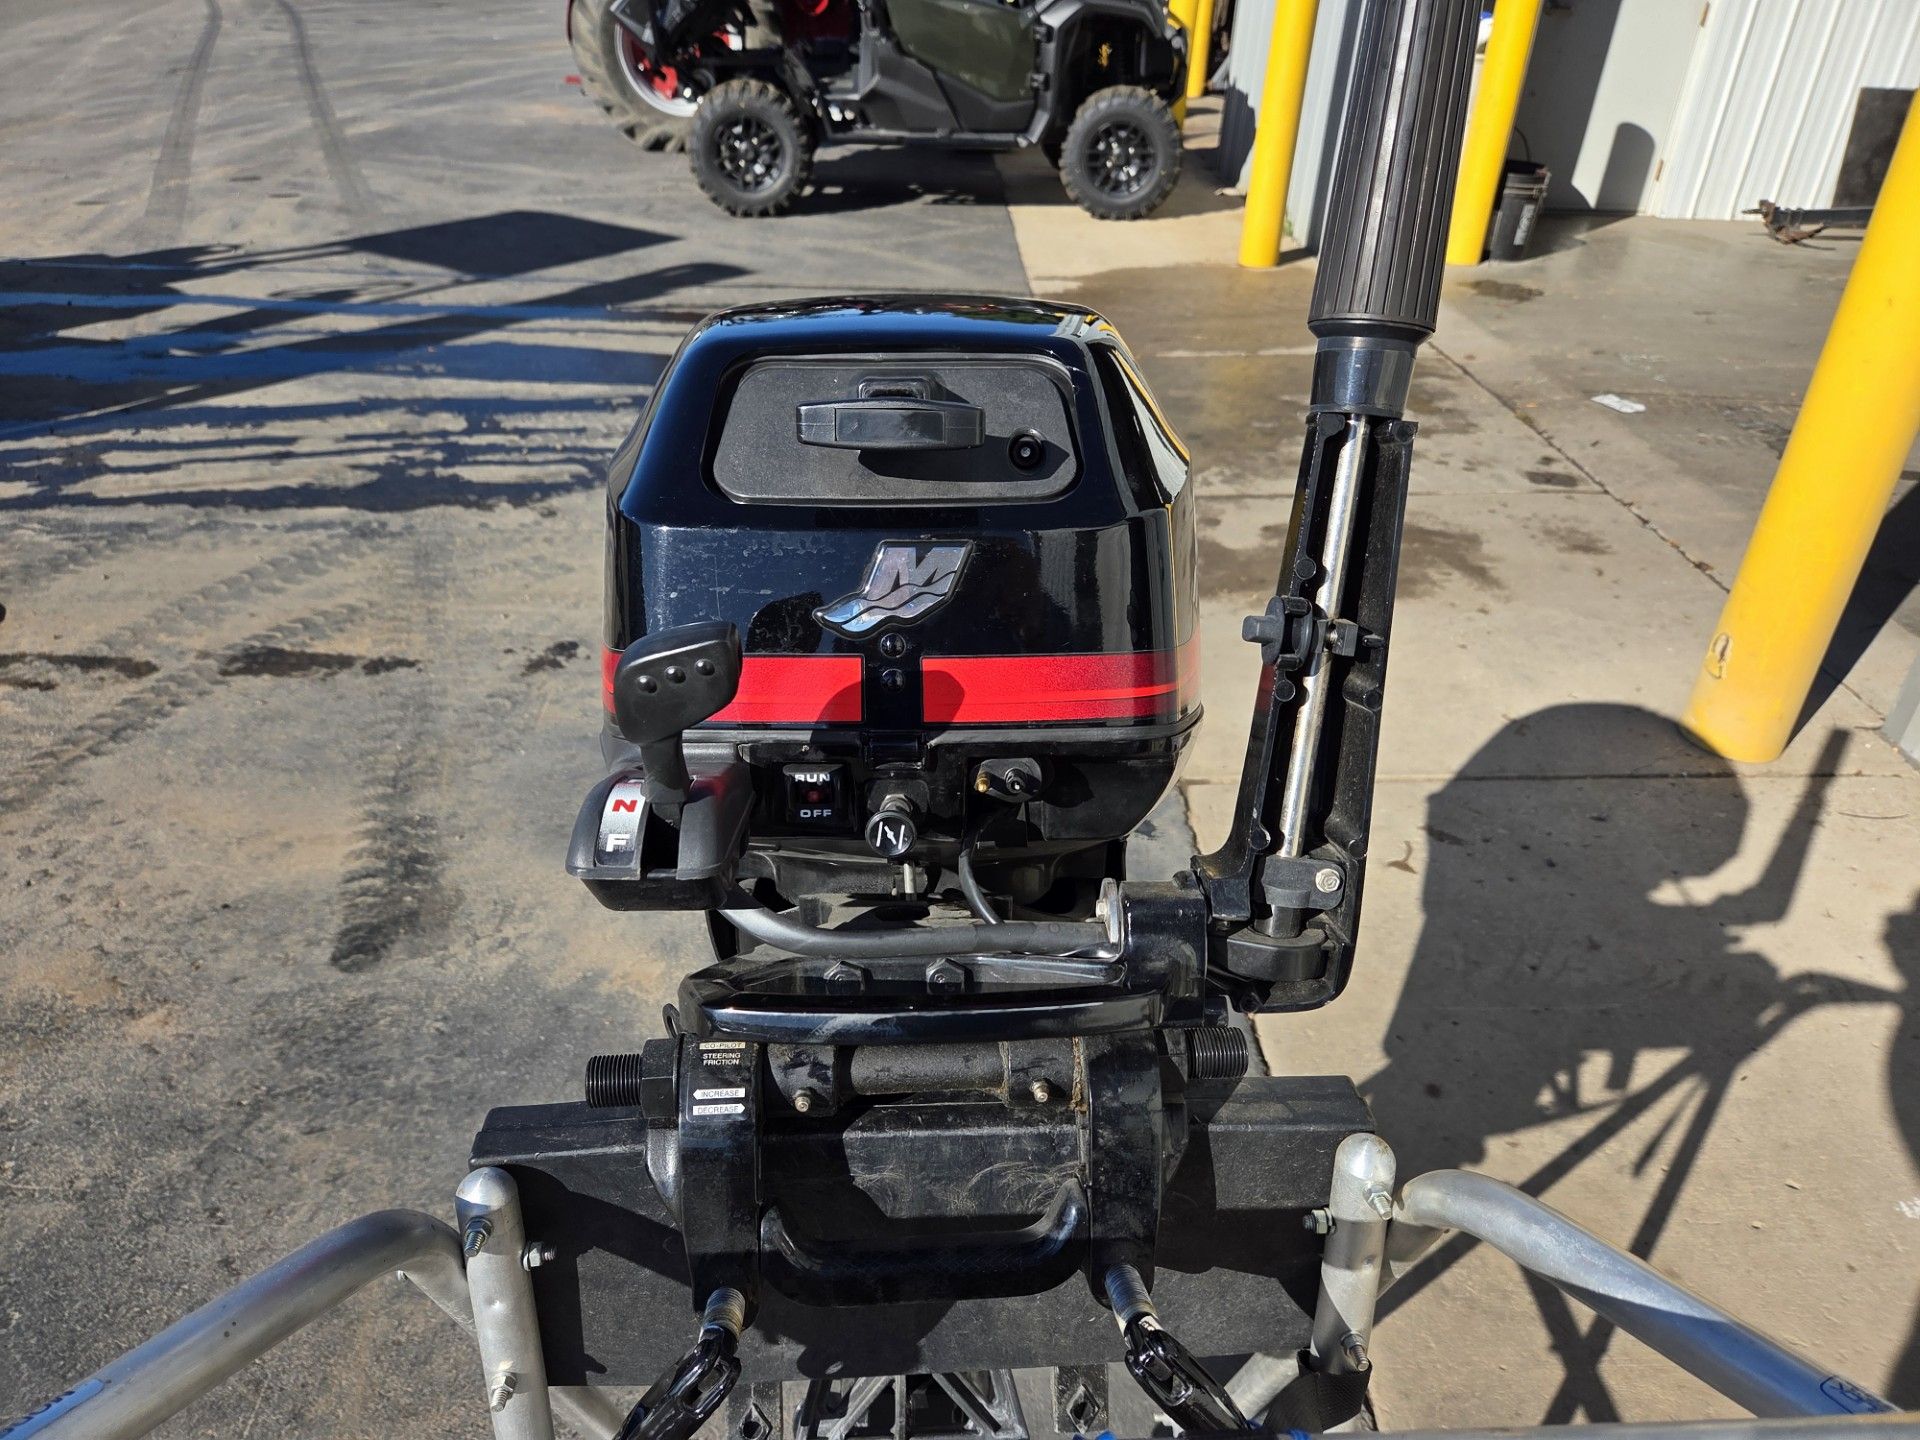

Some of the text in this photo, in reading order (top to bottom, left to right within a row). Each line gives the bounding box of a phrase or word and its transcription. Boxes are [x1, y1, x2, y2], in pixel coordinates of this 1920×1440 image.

[794, 773, 831, 782] RUN
[612, 799, 638, 812] N
[800, 809, 832, 818] OFF
[605, 833, 631, 852] F
[701, 1089, 740, 1098] INCREASE
[697, 1105, 739, 1114] DECREASE
